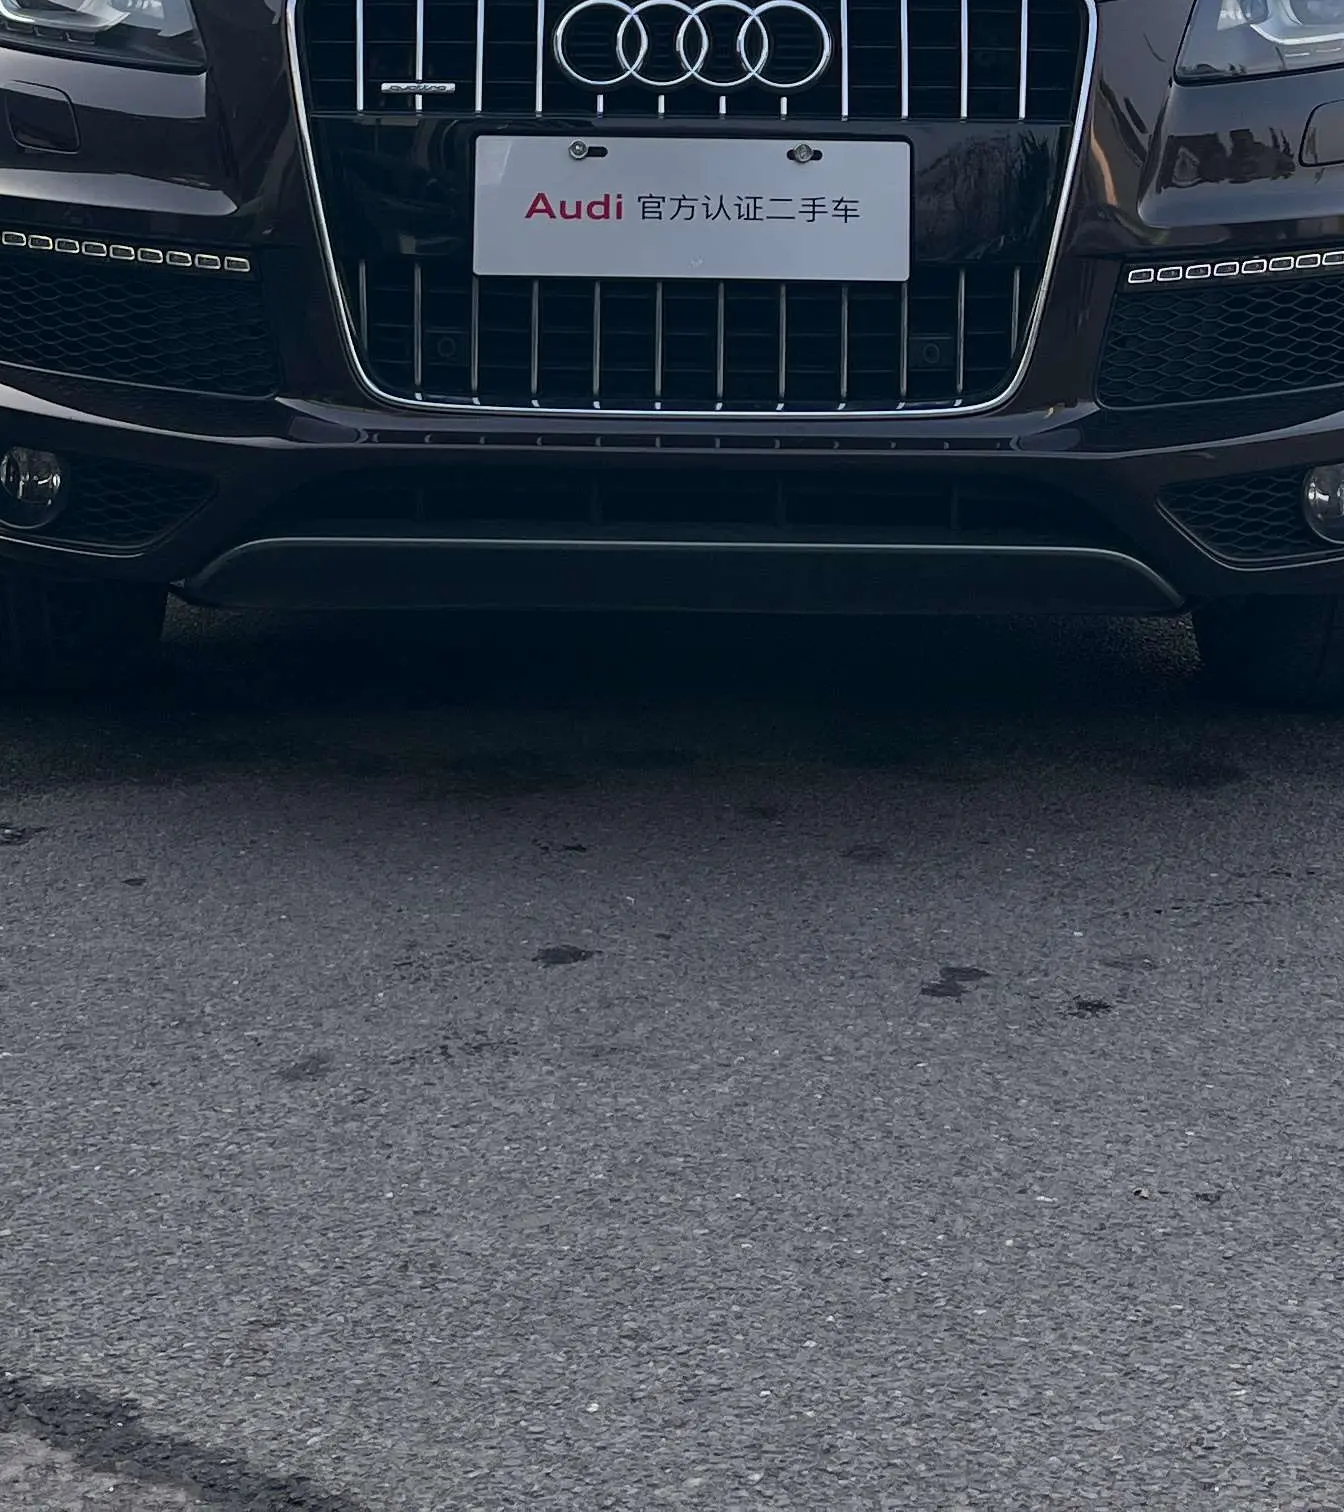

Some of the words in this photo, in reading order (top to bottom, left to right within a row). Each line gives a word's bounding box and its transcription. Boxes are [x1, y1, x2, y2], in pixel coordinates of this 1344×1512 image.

[524, 192, 624, 221] Audi
[636, 193, 862, 224] 官方认证二手车
